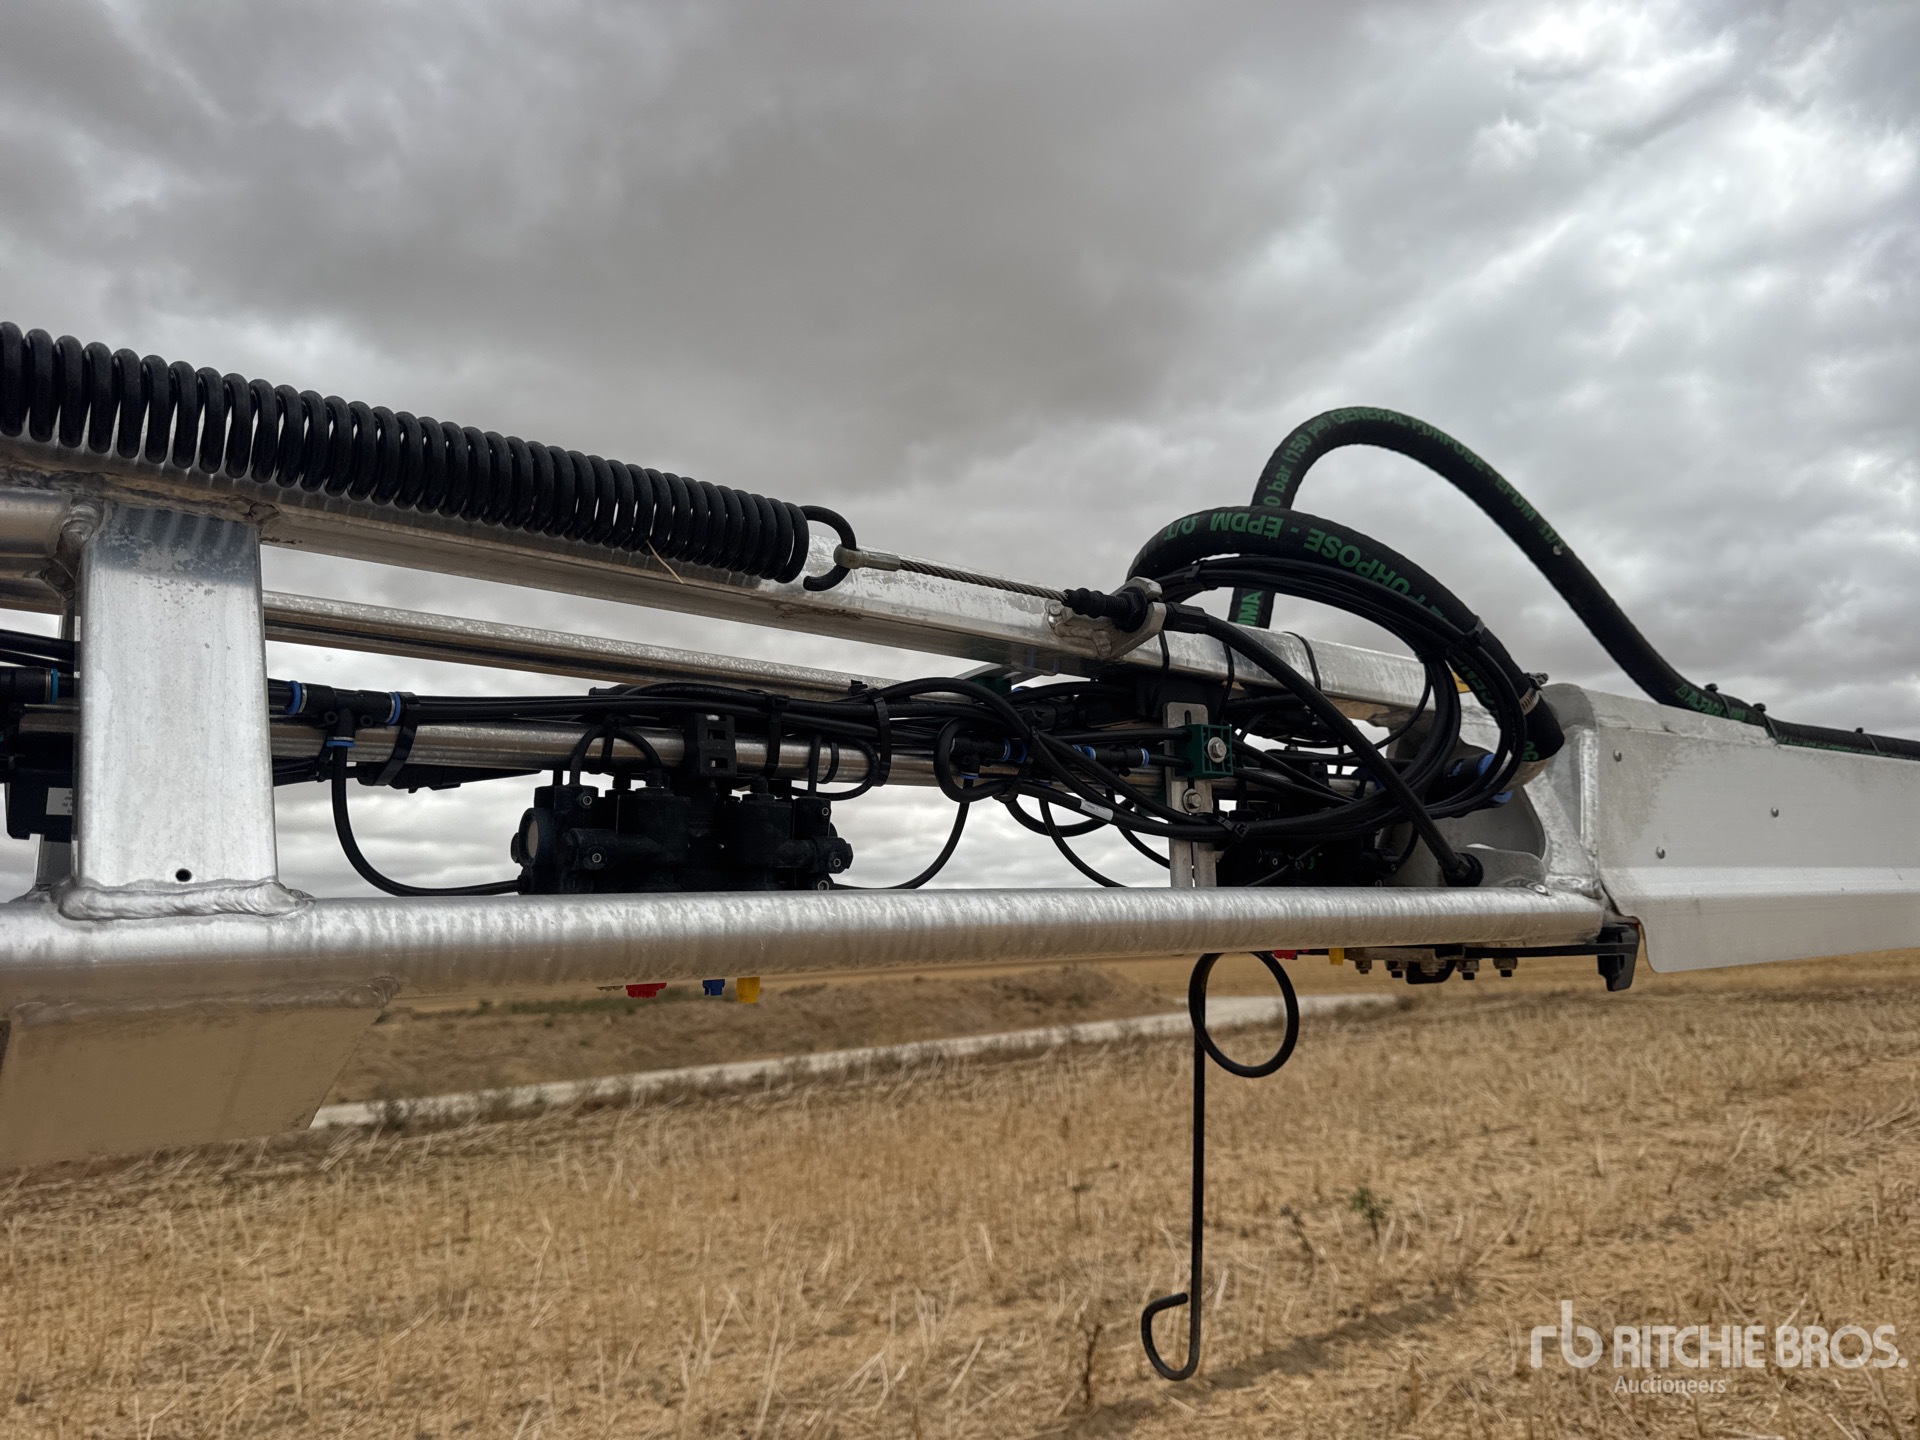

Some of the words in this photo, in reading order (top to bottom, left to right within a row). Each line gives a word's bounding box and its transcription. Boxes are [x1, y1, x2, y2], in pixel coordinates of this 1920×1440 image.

[1266, 464, 1292, 494] bar
[1284, 433, 1313, 464] (150
[1210, 512, 1285, 539] EPDM
